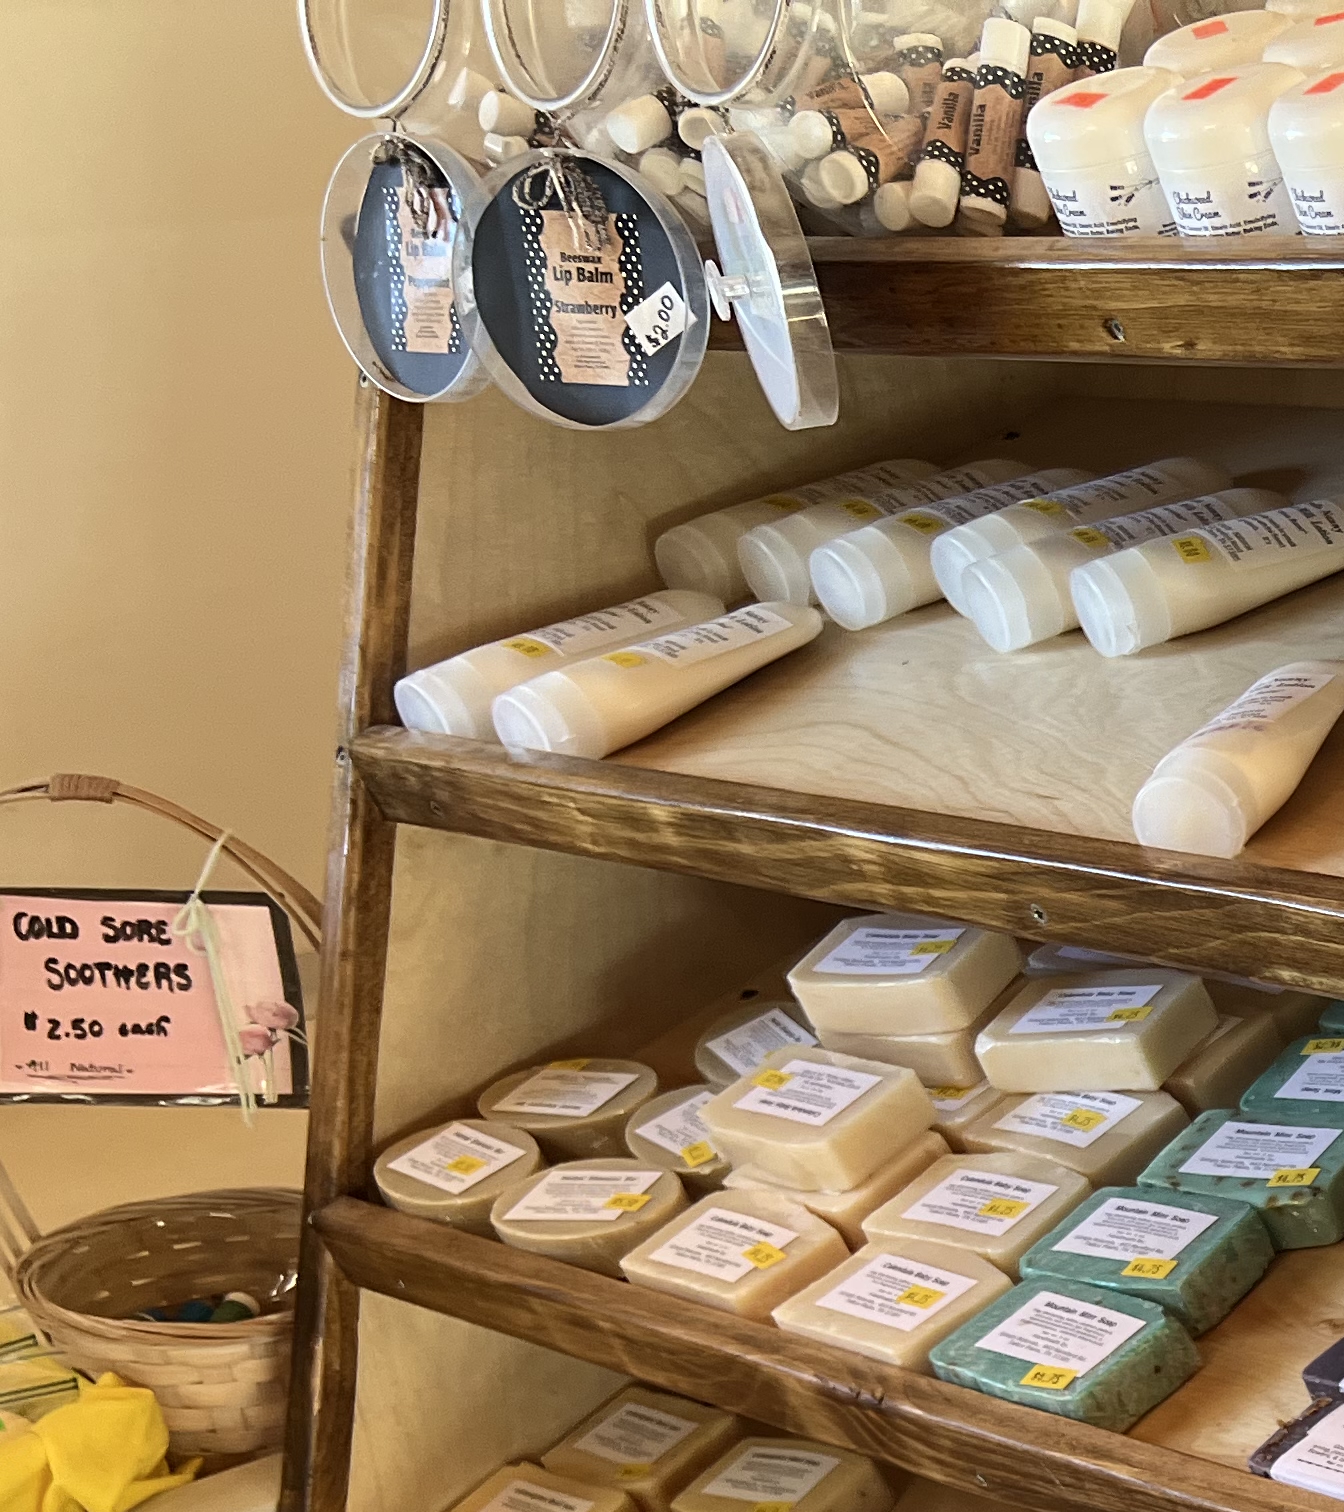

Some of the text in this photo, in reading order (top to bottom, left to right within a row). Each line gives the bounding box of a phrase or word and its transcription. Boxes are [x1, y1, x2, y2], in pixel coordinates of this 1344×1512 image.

[936, 90, 960, 131] Vanilla
[968, 102, 988, 157] Vanilla
[552, 265, 614, 286] Lip Balm
[560, 252, 603, 264] Beeswax
[555, 301, 618, 319] Strawberry
[644, 294, 674, 349] $2.00
[12, 911, 173, 946] COLD SORE
[44, 956, 193, 993] SOOTHERS
